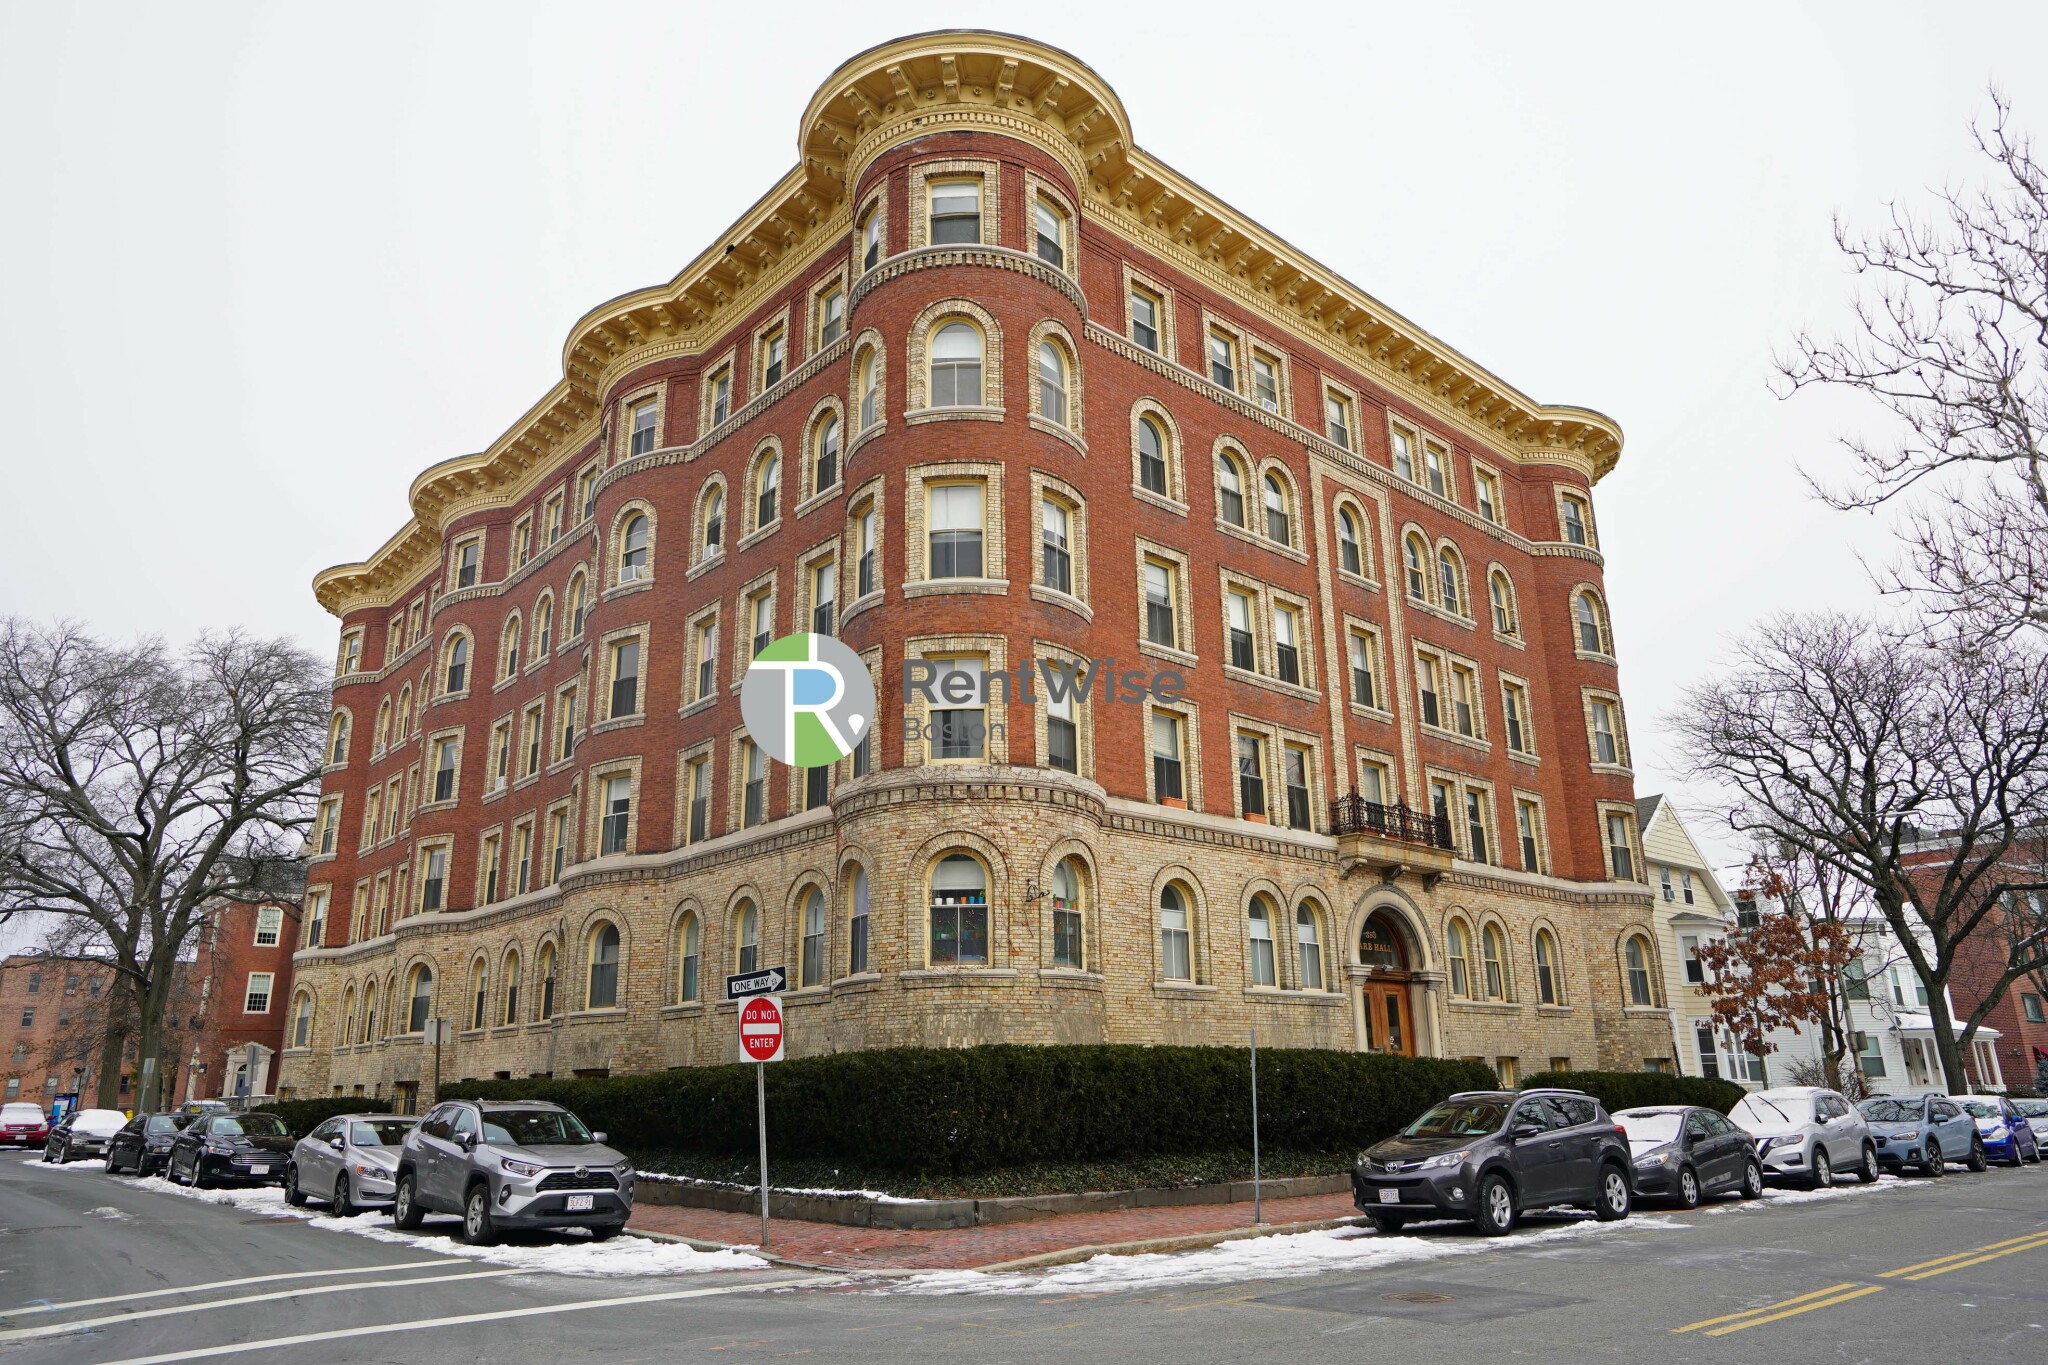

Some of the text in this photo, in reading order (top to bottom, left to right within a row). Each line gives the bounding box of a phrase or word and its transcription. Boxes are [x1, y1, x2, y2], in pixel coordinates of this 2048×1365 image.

[1359, 942, 1392, 953] ARE HALL
[734, 977, 770, 992] ONE WAY
[746, 1010, 776, 1020] DO NOT
[749, 1038, 774, 1048] ENTER
